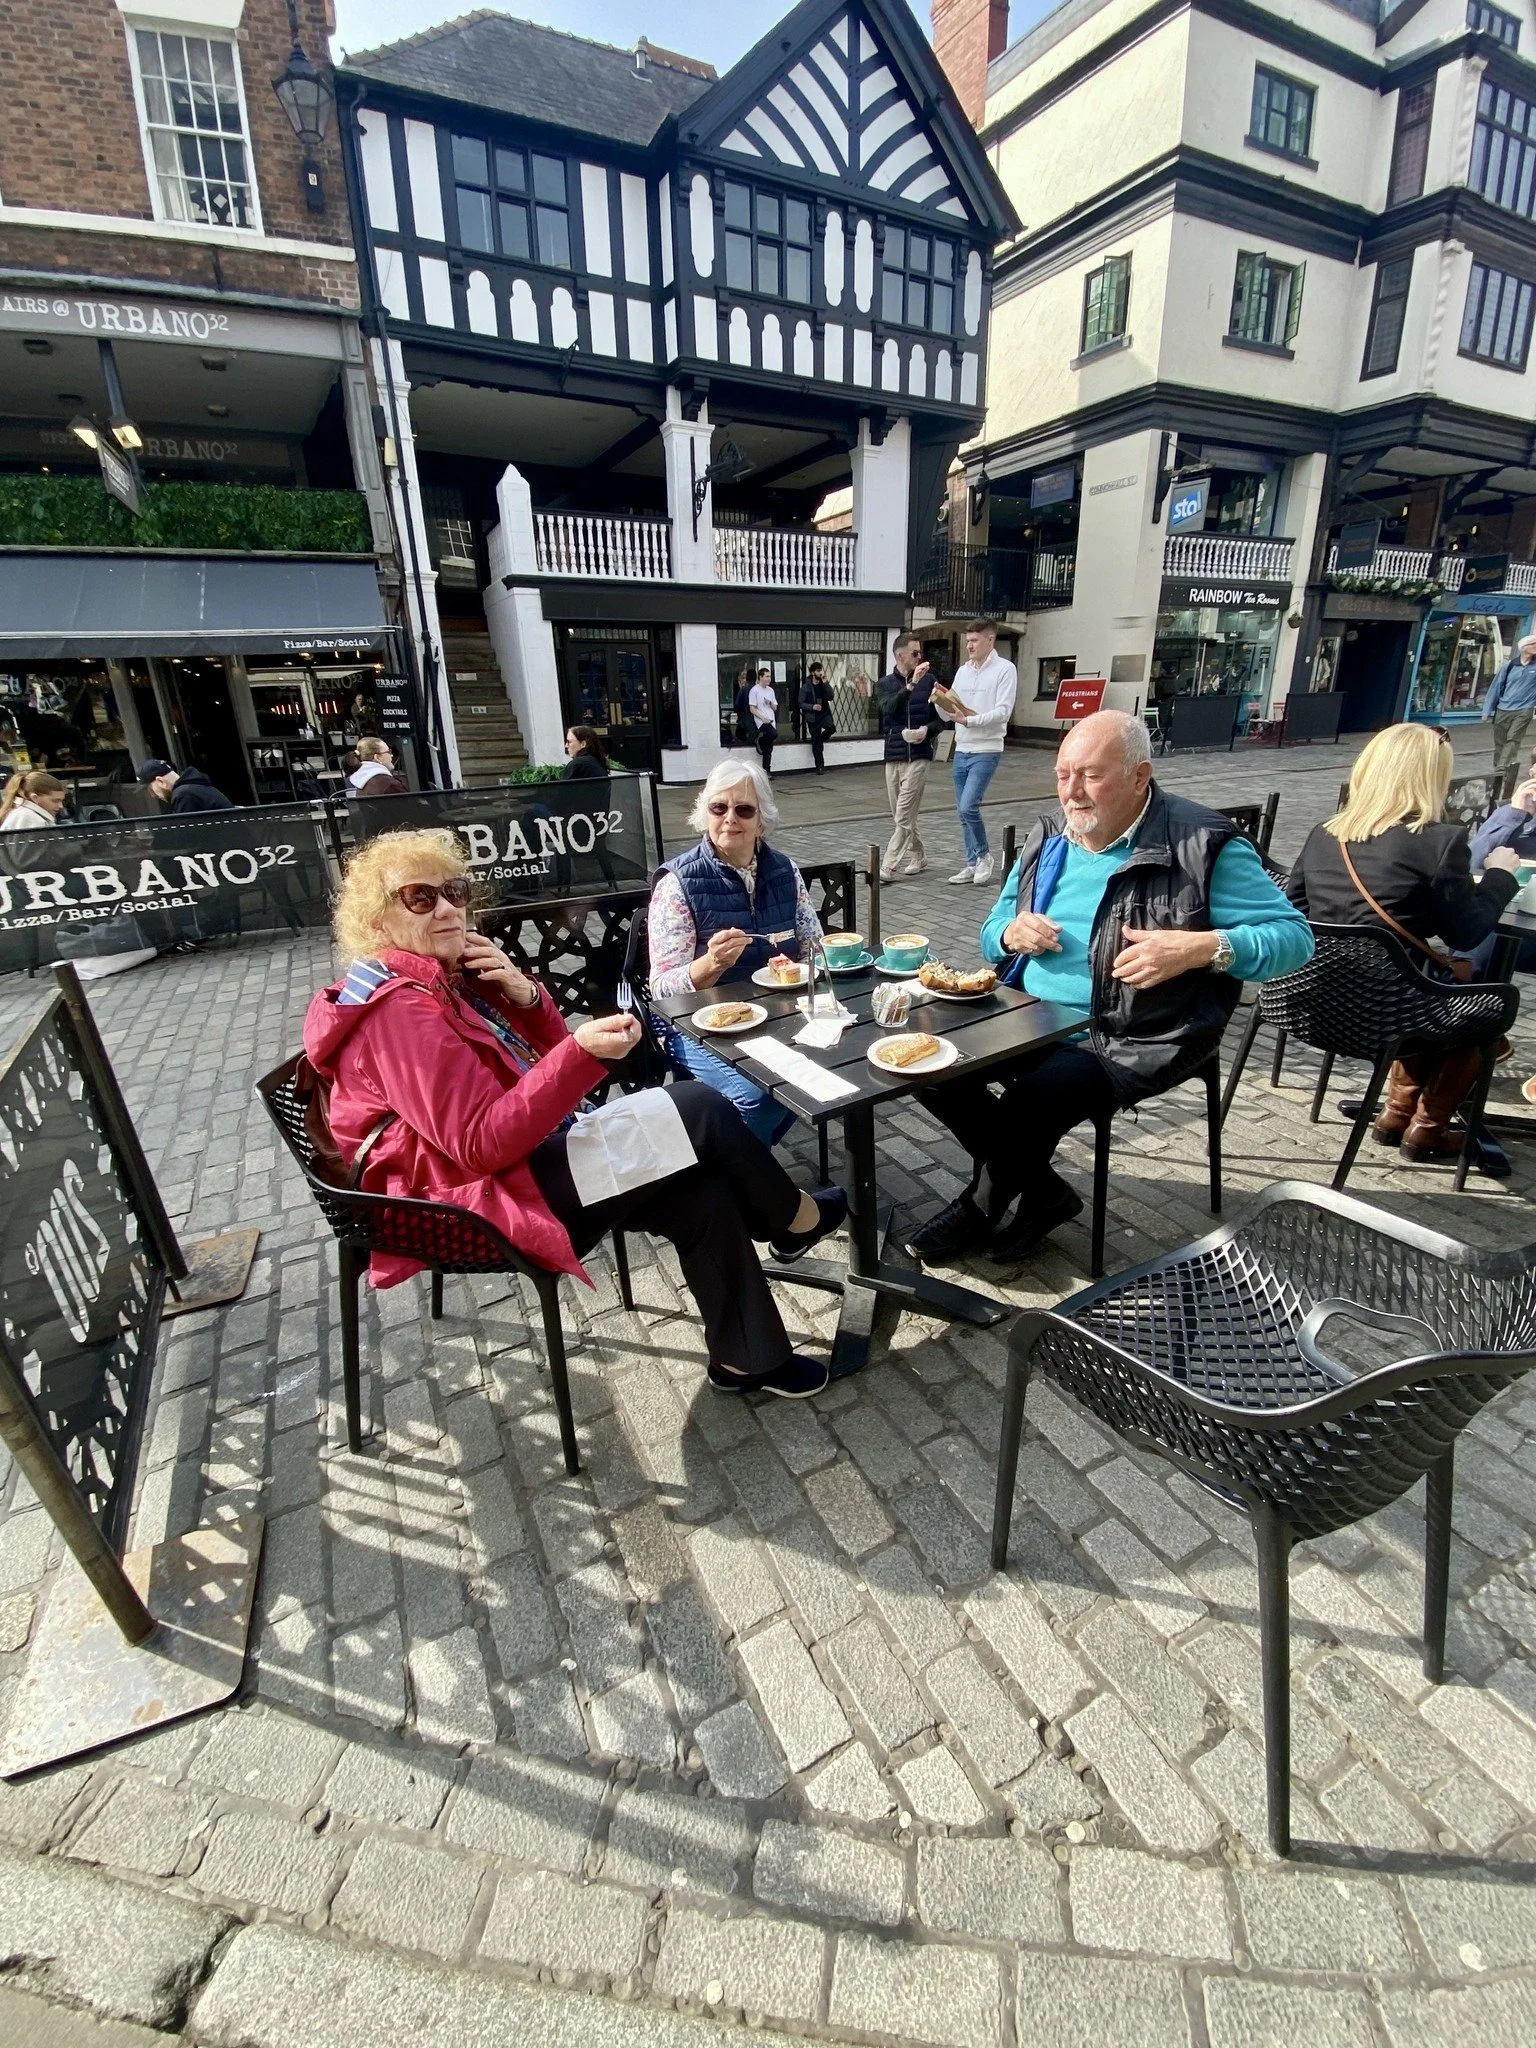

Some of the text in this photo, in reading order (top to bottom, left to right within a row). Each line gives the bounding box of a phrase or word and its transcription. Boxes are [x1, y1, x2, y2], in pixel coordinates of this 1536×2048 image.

[0, 296, 229, 339] AIRS @ URBANO32
[1189, 588, 1243, 604] RAINBOW
[1257, 593, 1280, 605] Rooms
[283, 638, 371, 649] Pizza/Bar/Social
[452, 810, 625, 867] BANO32
[0, 894, 198, 930] izza/Bar/Social
